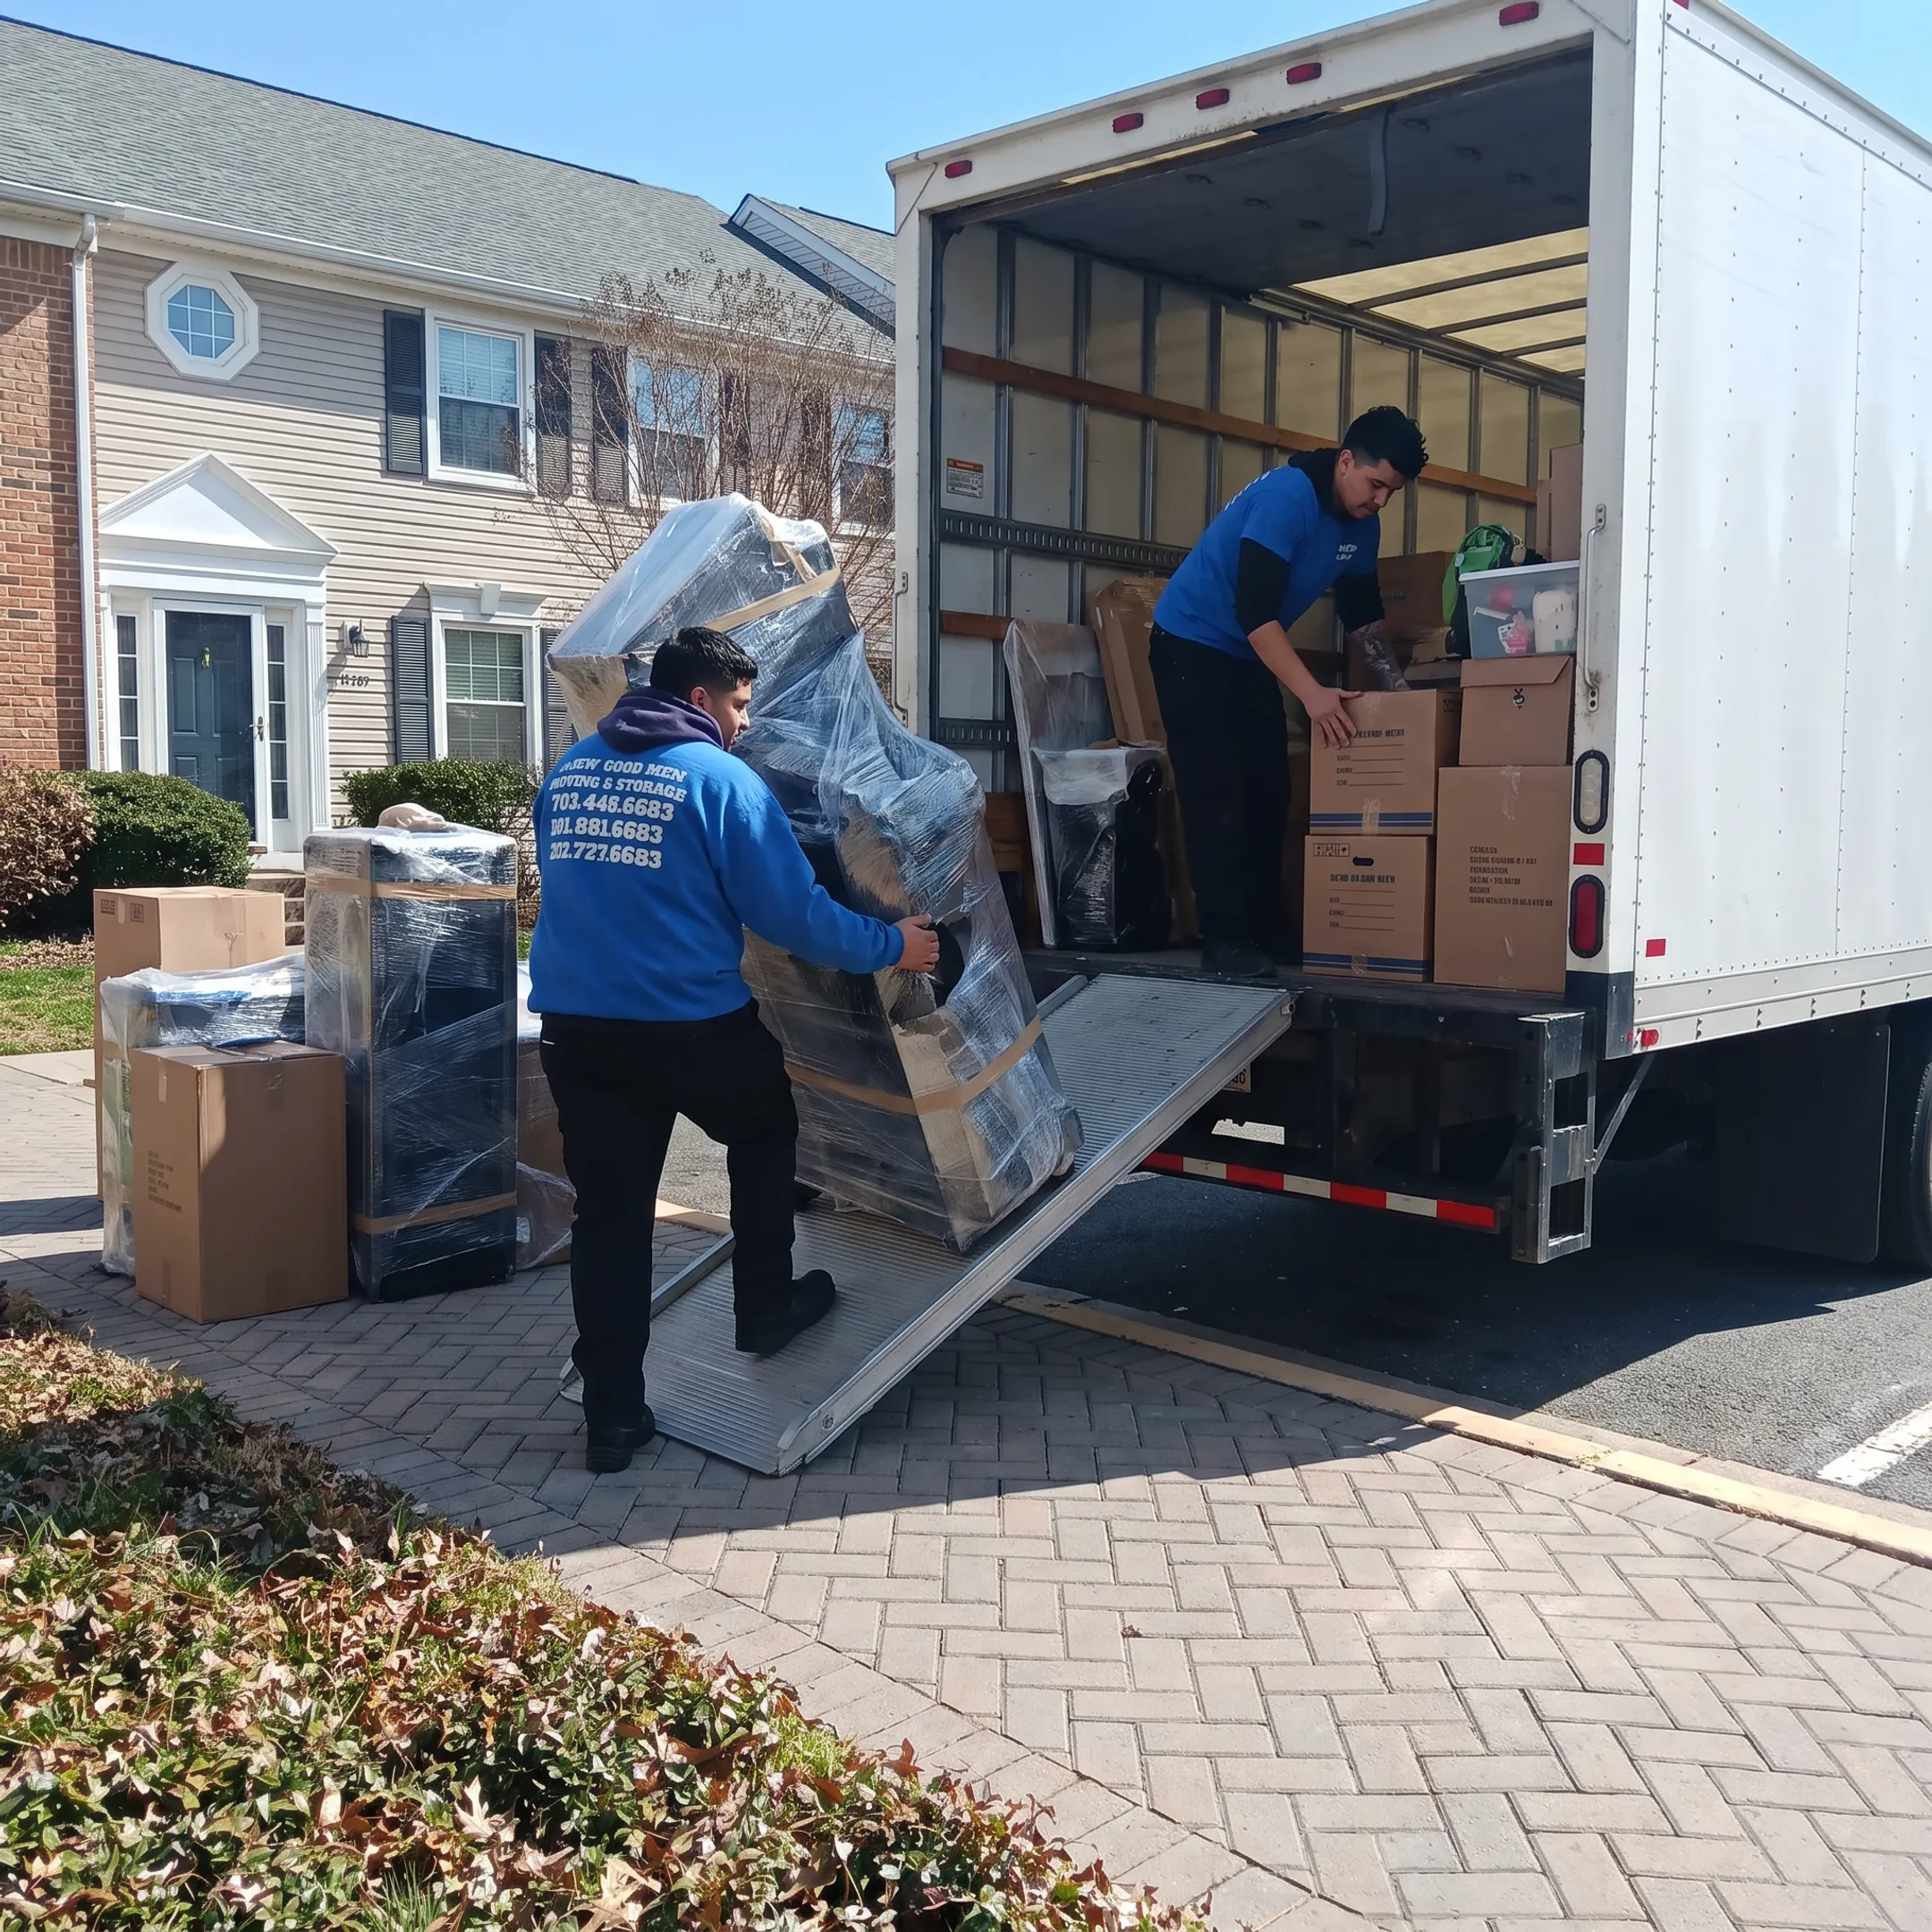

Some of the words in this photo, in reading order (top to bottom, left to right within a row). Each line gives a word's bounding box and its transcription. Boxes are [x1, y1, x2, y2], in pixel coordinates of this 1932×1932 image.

[603, 759, 643, 775] GOOD
[645, 763, 688, 783] MEN
[602, 777, 614, 790] &
[615, 778, 688, 802] STORAGE
